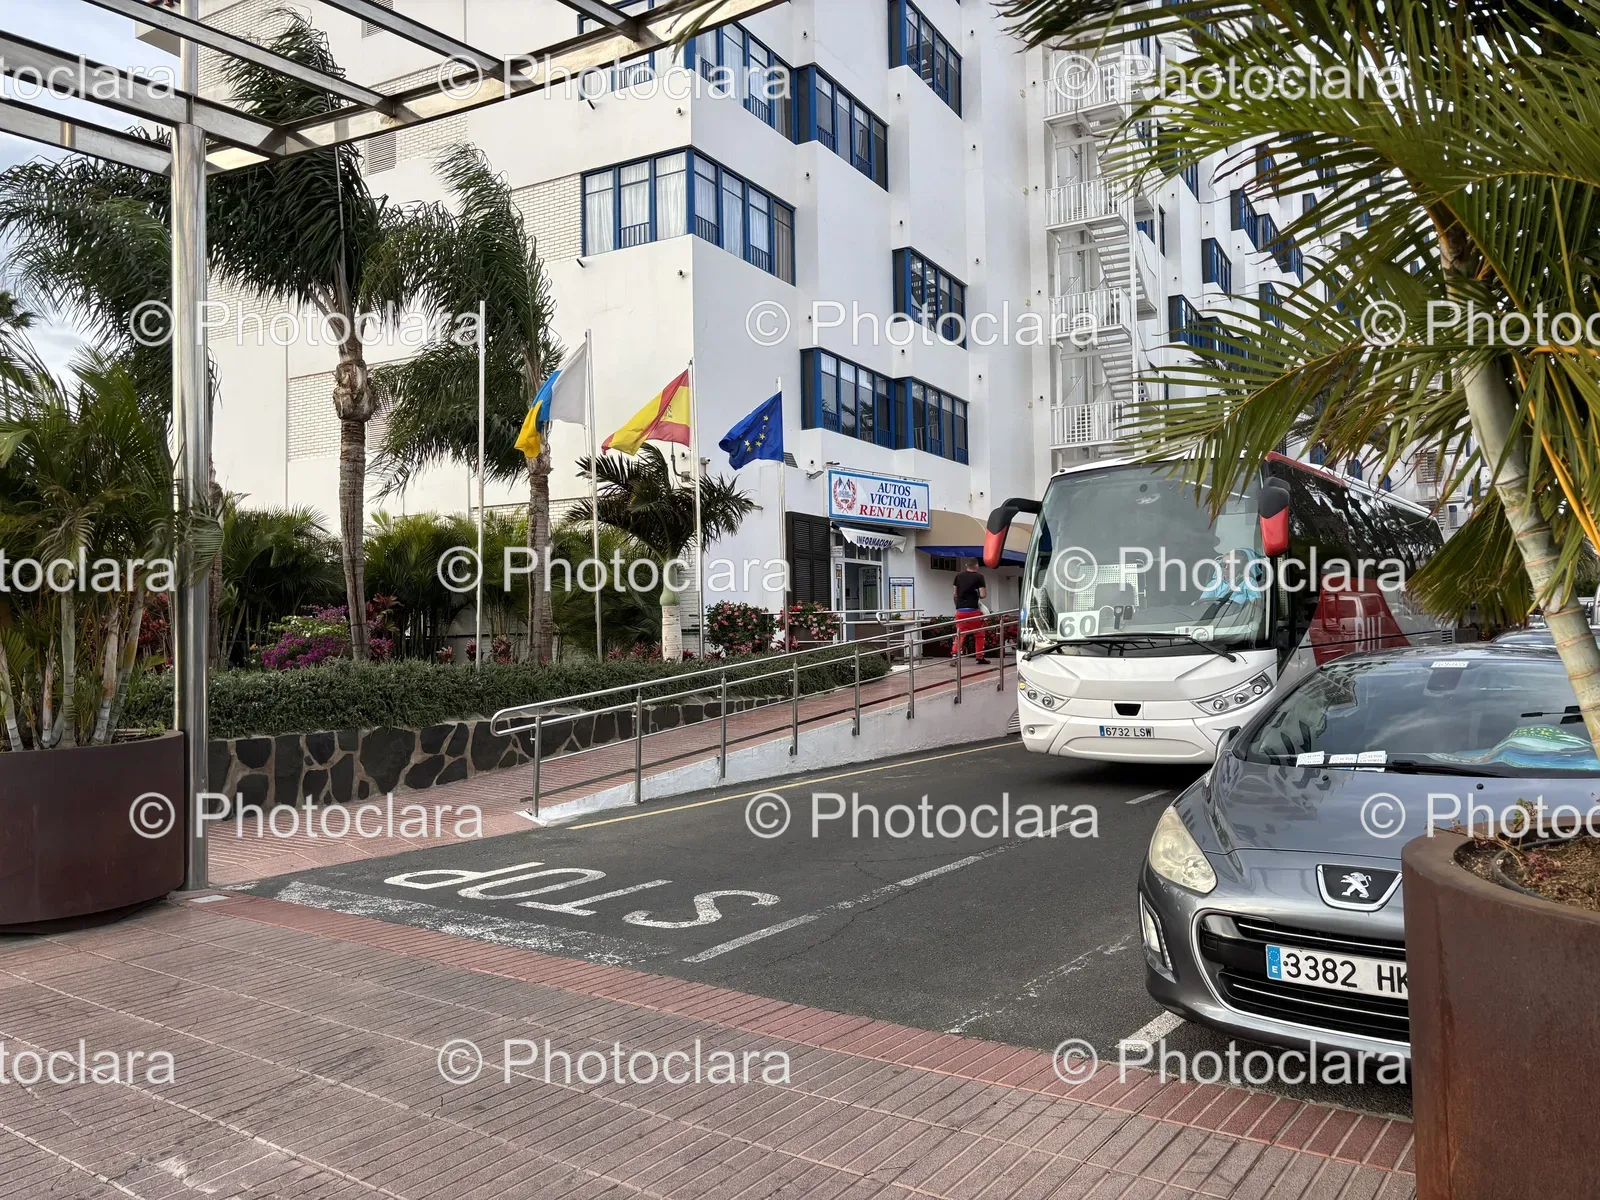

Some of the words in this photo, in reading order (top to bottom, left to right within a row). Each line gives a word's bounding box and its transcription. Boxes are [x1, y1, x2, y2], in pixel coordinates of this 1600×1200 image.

[877, 482, 911, 497] AUTOS
[870, 493, 918, 510] VICTORIA
[859, 504, 894, 518] RENT
[895, 508, 903, 520] A
[905, 509, 928, 522] CAR
[856, 535, 894, 548] INFORMACION
[1059, 615, 1097, 638] 60
[1105, 727, 1130, 737] 6732
[1133, 727, 1152, 738] LSW
[383, 861, 781, 929] STOP
[1271, 965, 1279, 974] E
[1285, 952, 1358, 988] 3382
[1376, 964, 1408, 993] HK
